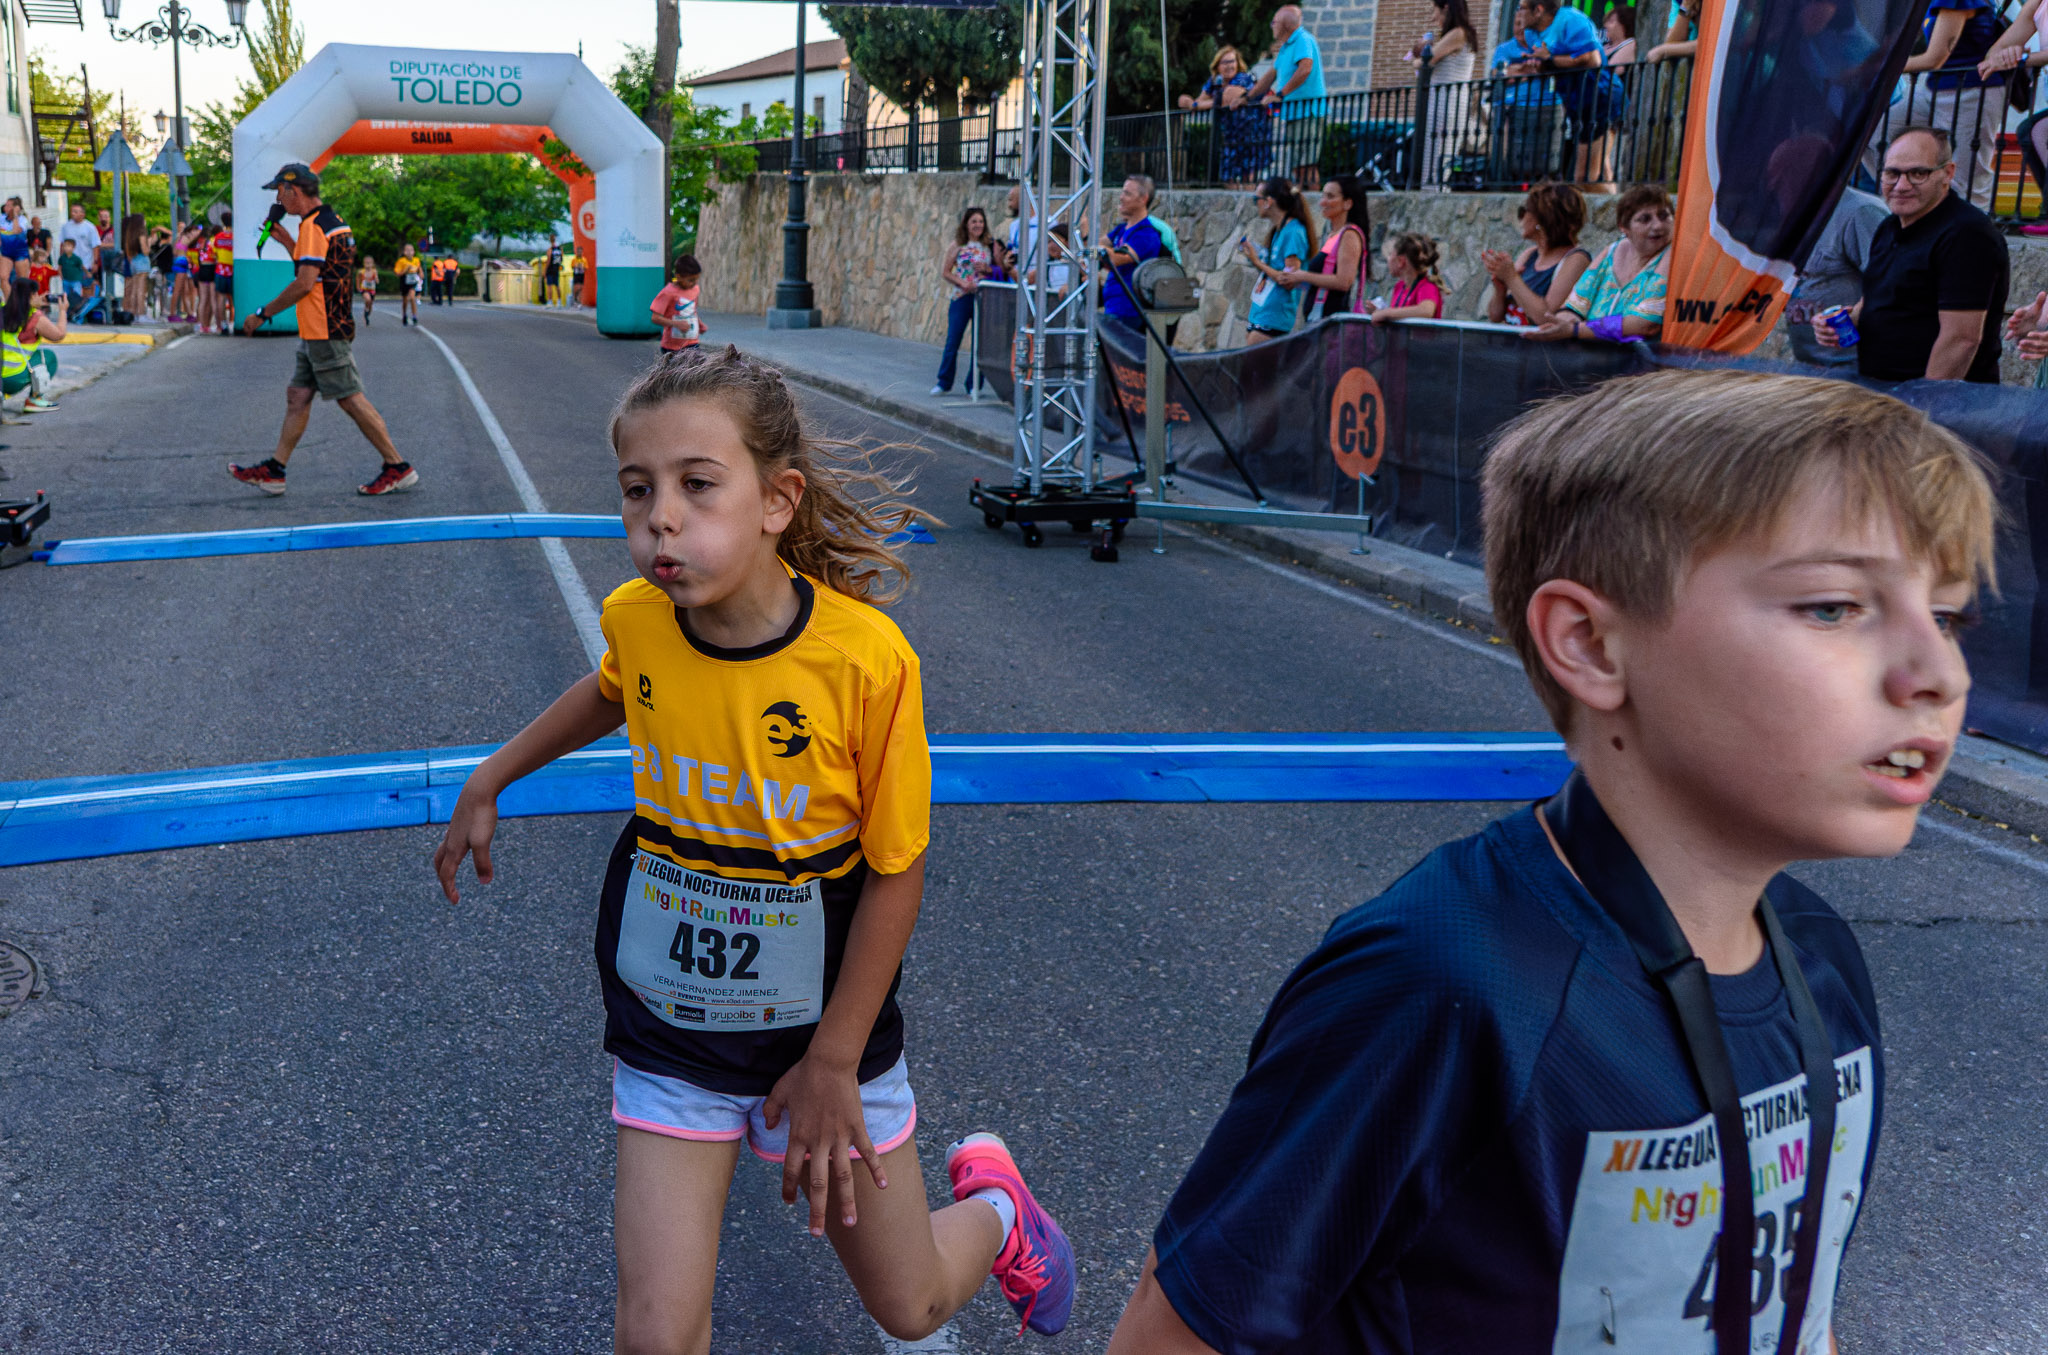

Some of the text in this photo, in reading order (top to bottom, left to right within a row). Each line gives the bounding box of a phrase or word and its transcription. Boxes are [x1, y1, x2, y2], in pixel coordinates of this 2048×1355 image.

[390, 61, 523, 80] DIPUTACIÓN DE
[391, 76, 522, 107] TOLEDO
[411, 131, 453, 145] SALIDA
[1338, 392, 1377, 458] e3
[631, 742, 810, 822] e3 TEAM
[647, 859, 682, 887] LEGUA
[683, 872, 761, 903] NOCTURNA
[764, 885, 812, 904] UGENA
[668, 920, 761, 980] 432
[654, 973, 778, 997] VERA HERNANDEZ JIMENEZ
[678, 992, 705, 1002] EVENTOS
[710, 1010, 756, 1020] grupoibc
[1639, 1124, 1716, 1170] LEGUA
